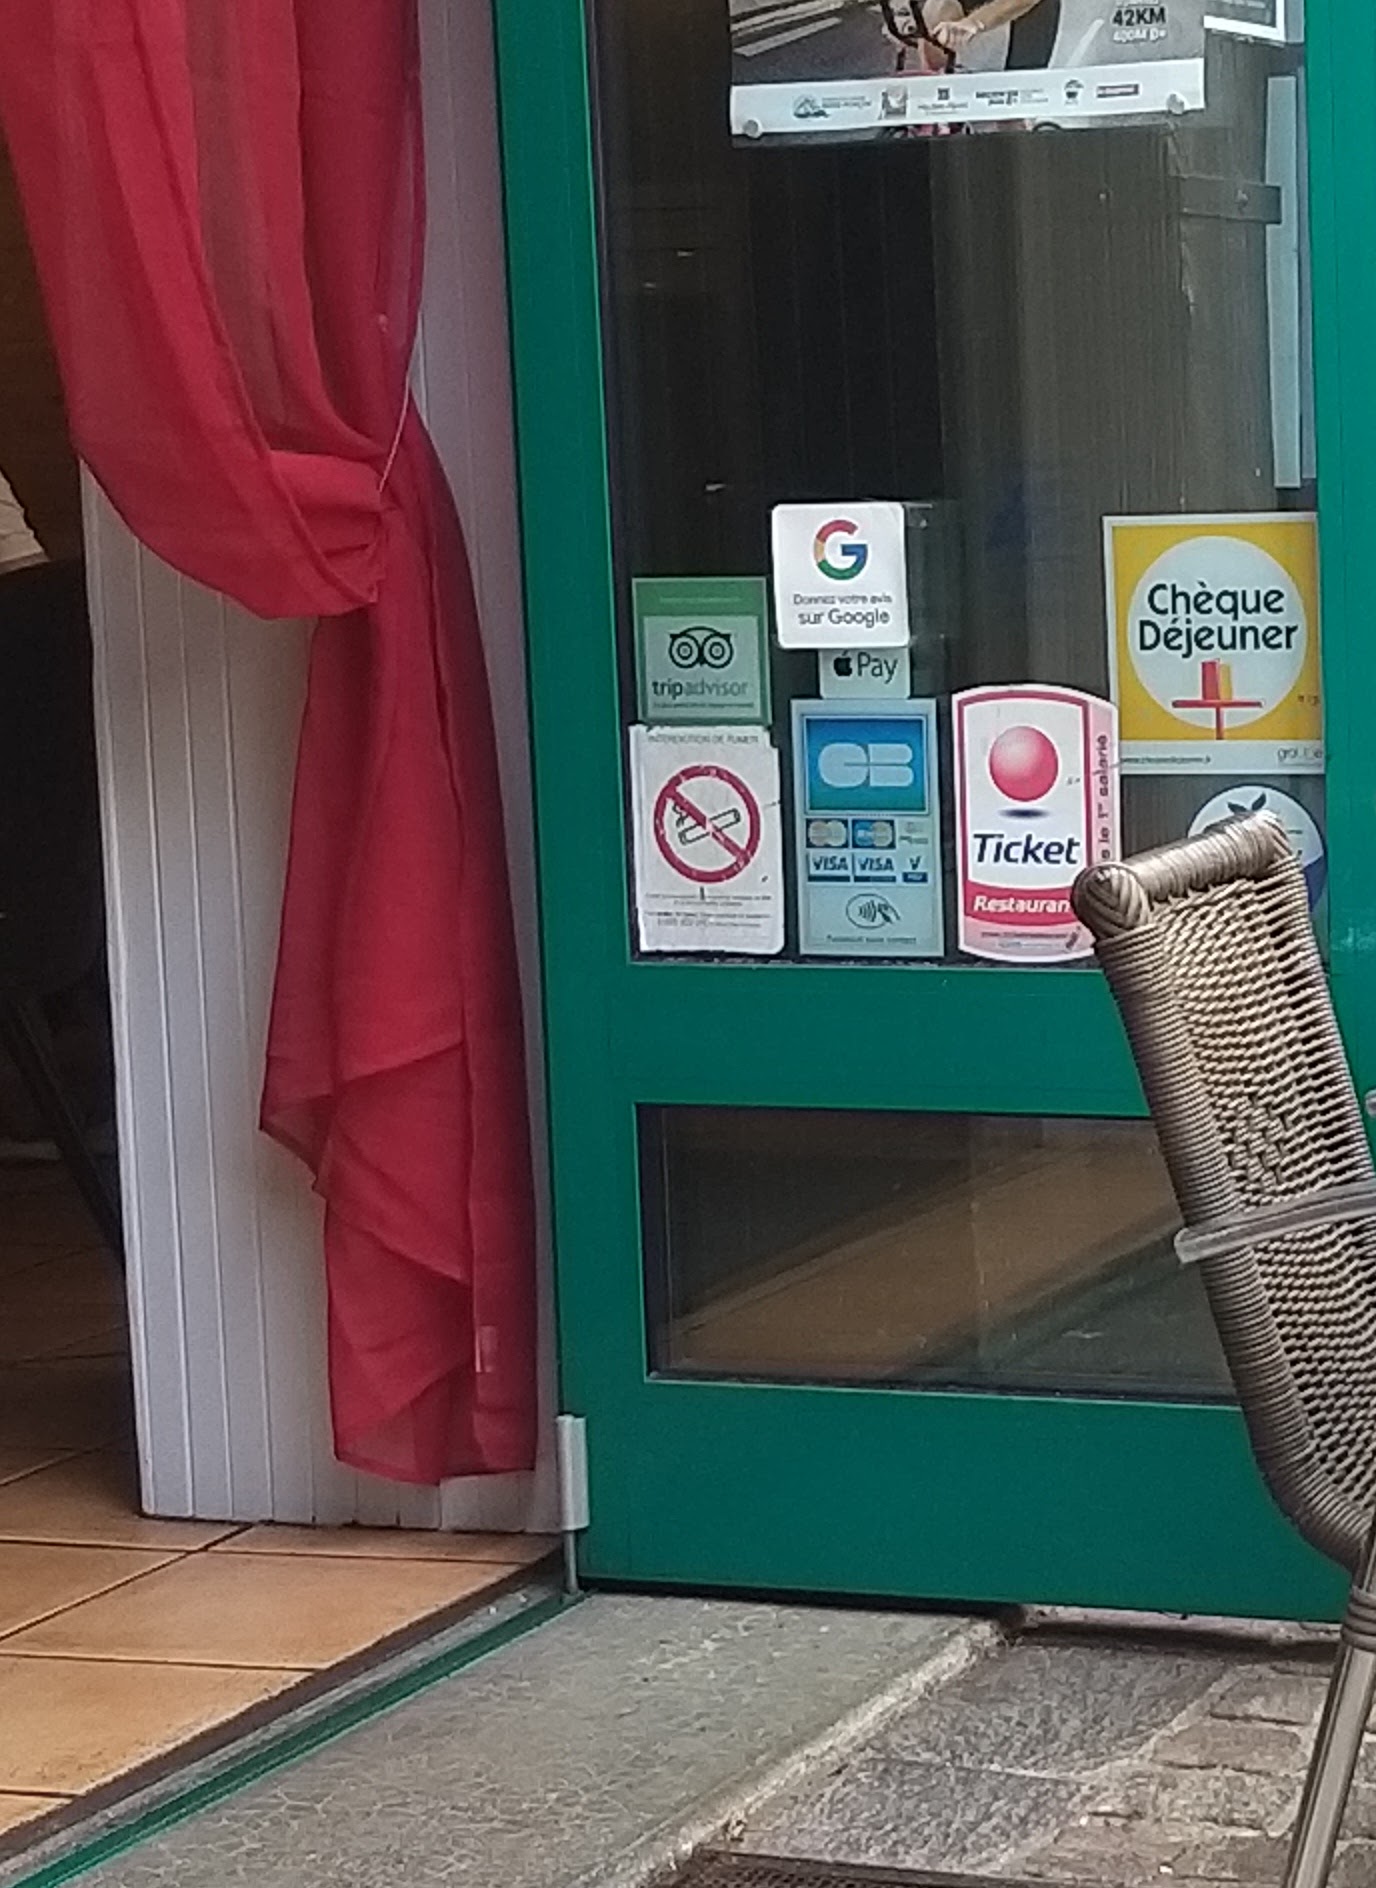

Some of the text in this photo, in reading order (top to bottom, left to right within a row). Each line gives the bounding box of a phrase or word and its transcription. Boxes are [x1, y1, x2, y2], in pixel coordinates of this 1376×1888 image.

[1112, 7, 1167, 27] 42KM
[793, 592, 893, 605] Donnez votre avis
[1147, 580, 1286, 619] Chèque
[798, 608, 890, 628] sur Google
[1139, 616, 1299, 658] Déjeuner
[858, 653, 899, 683] Pay
[652, 678, 749, 700] tripadvisor
[973, 833, 1081, 865] Ticket
[812, 855, 848, 871] VISA
[859, 856, 894, 871] VISA
[973, 895, 1071, 914] Restauran
